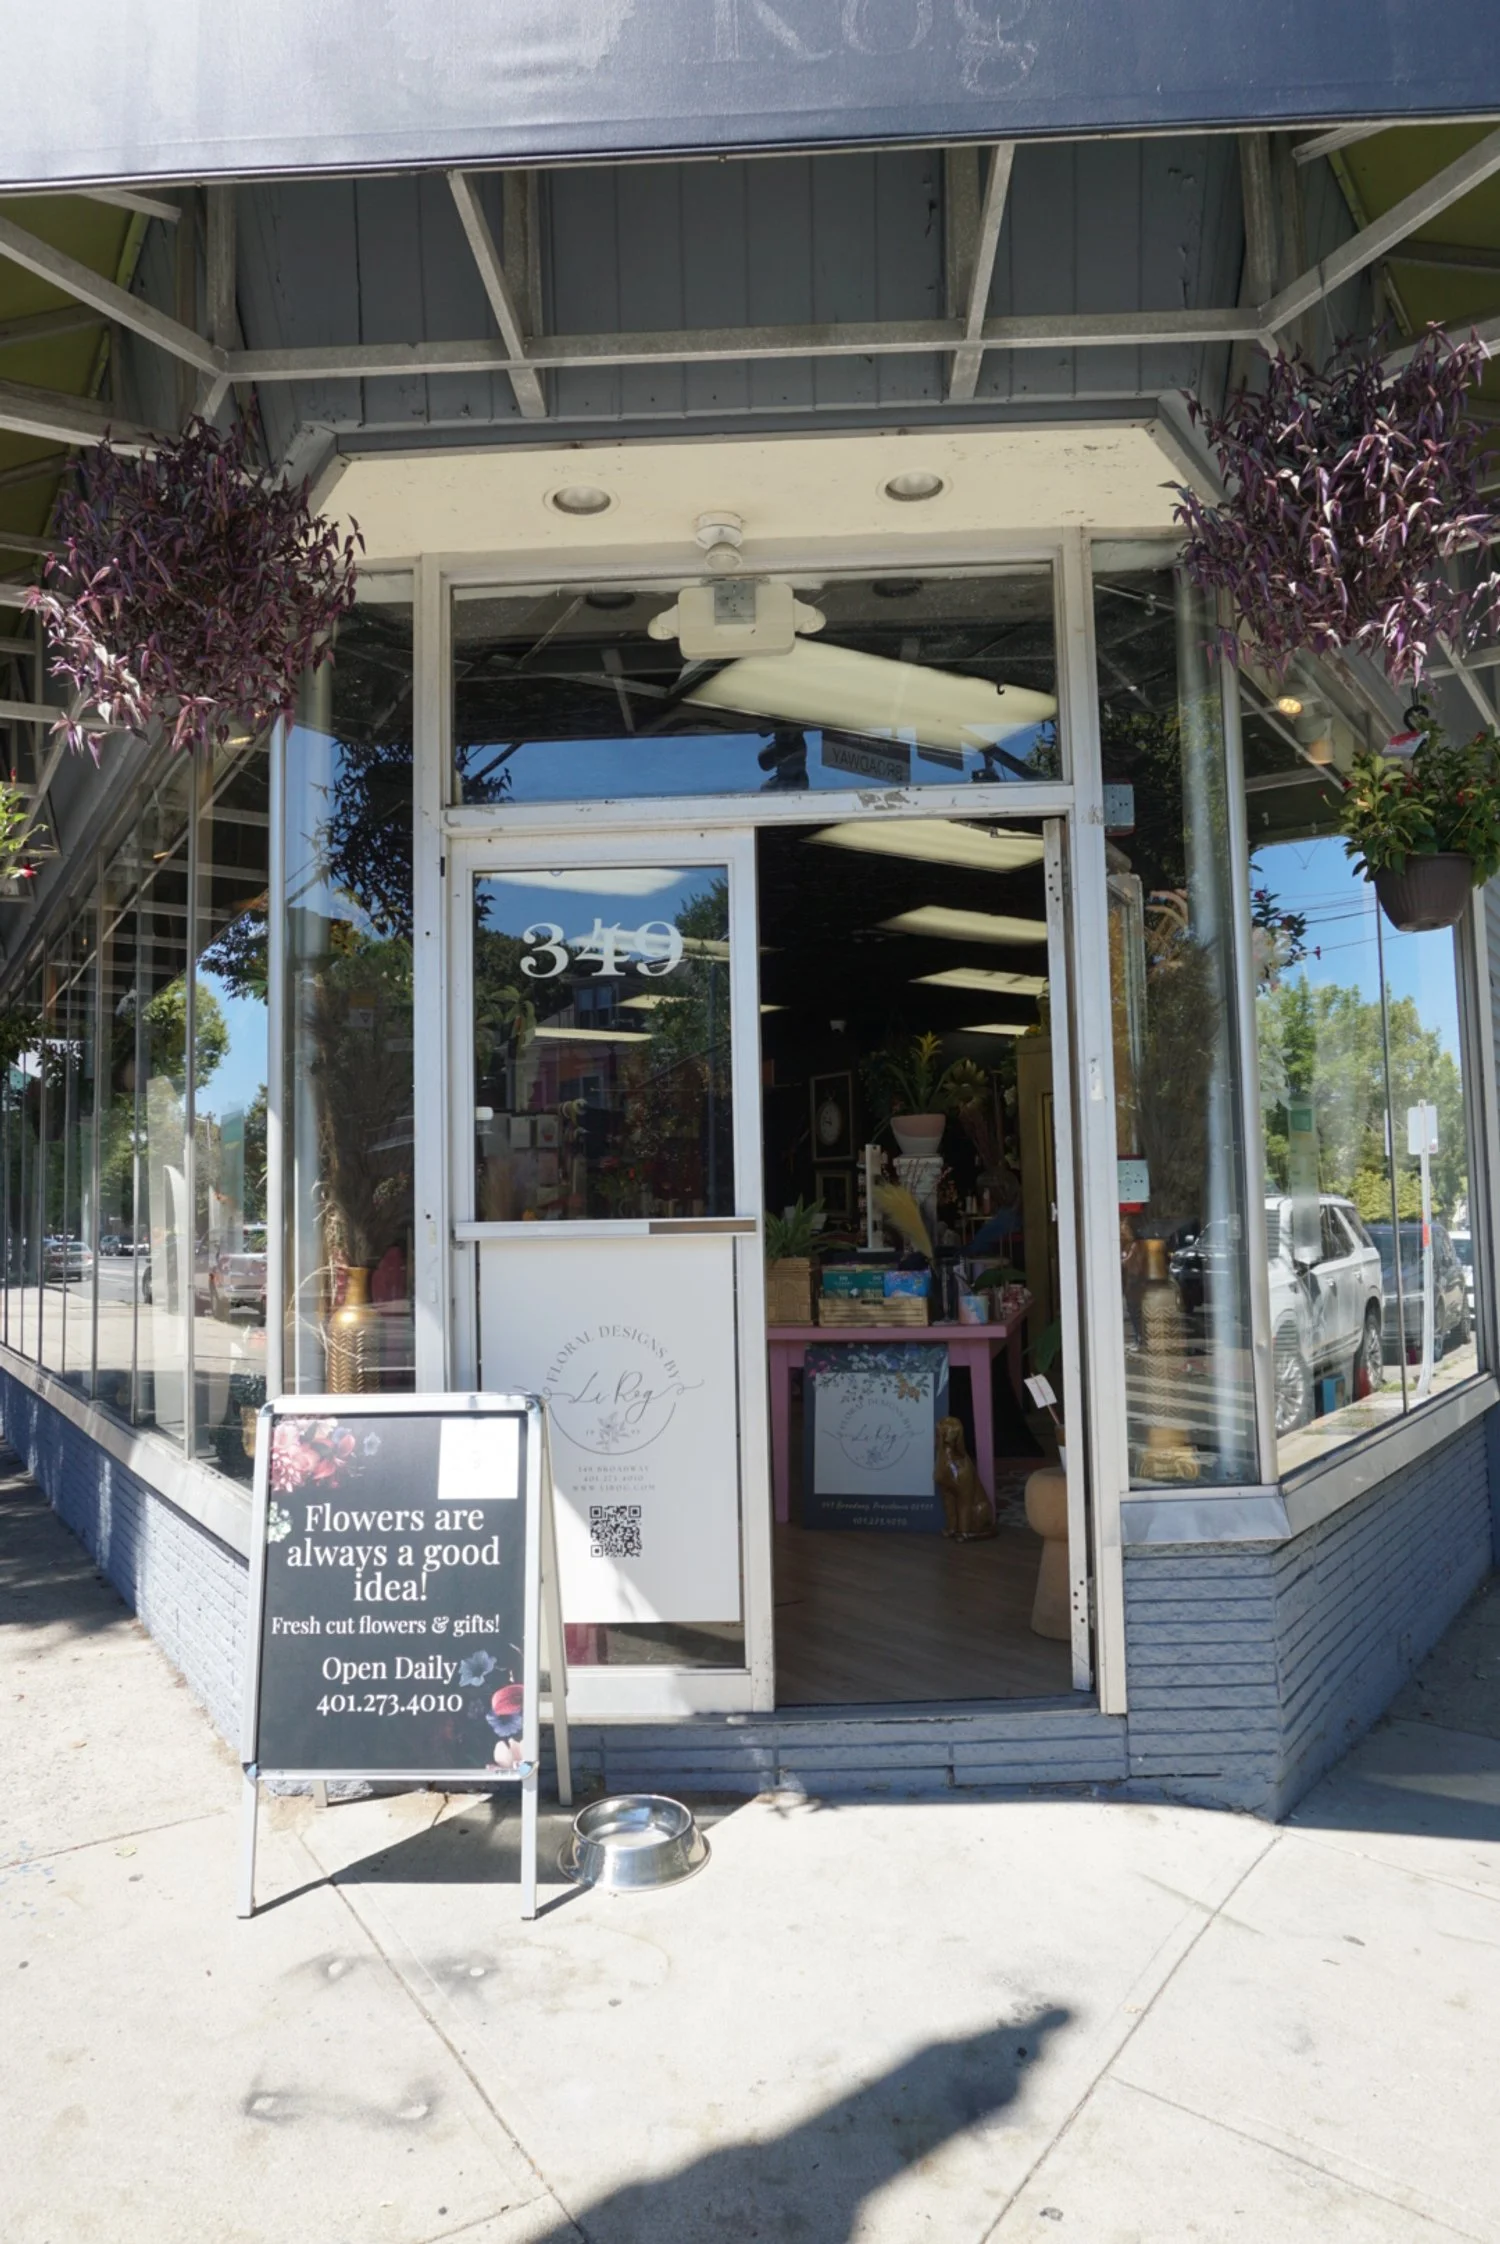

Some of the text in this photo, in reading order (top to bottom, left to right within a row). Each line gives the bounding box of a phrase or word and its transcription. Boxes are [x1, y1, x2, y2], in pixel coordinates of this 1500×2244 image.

[520, 918, 684, 978] 349
[546, 1324, 682, 1384] FLORAL DESIGNS BY
[305, 1502, 485, 1533] Flowers are
[287, 1536, 500, 1573] always a good
[353, 1568, 428, 1601] idea!
[271, 1614, 500, 1637] Fresh cut flowers & gifts!
[322, 1655, 458, 1684] Open Daily
[316, 1693, 463, 1717] 401.273.4010
